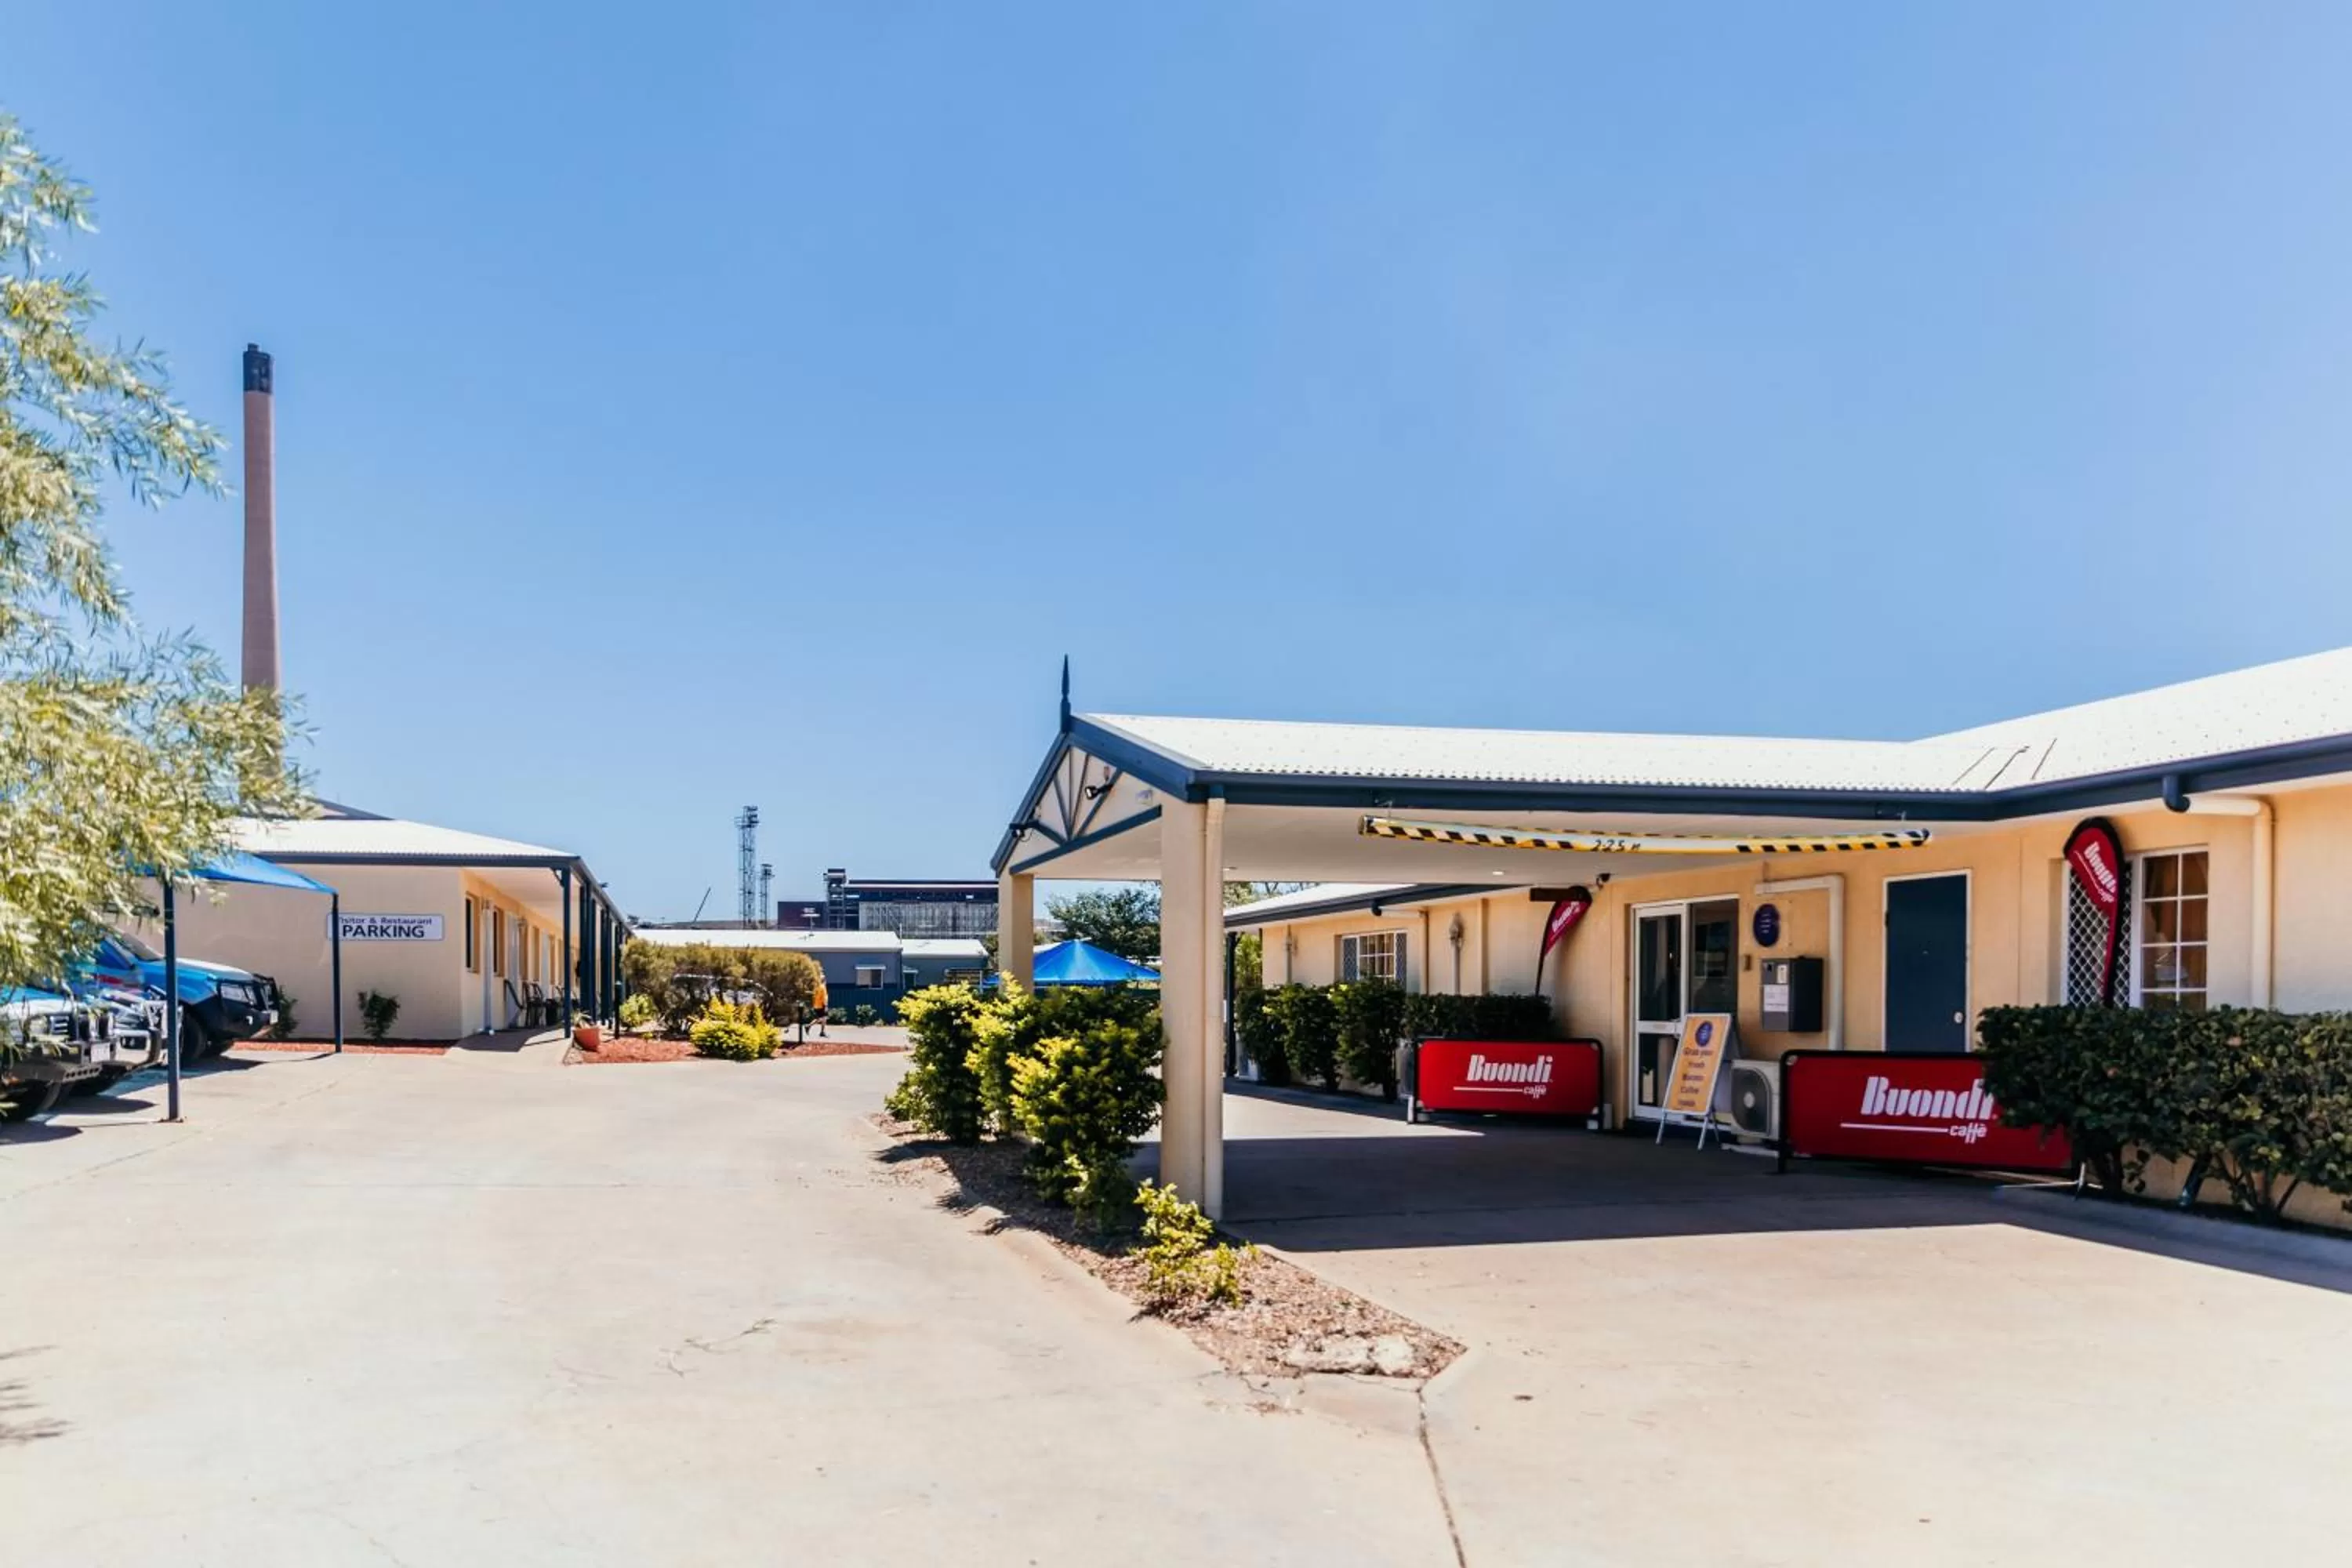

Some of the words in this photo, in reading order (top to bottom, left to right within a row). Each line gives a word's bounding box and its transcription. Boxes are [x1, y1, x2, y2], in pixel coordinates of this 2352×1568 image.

[342, 924, 425, 938] PARKING
[1466, 1054, 1553, 1083] Buondi
[1860, 1076, 1994, 1120] Buondi
